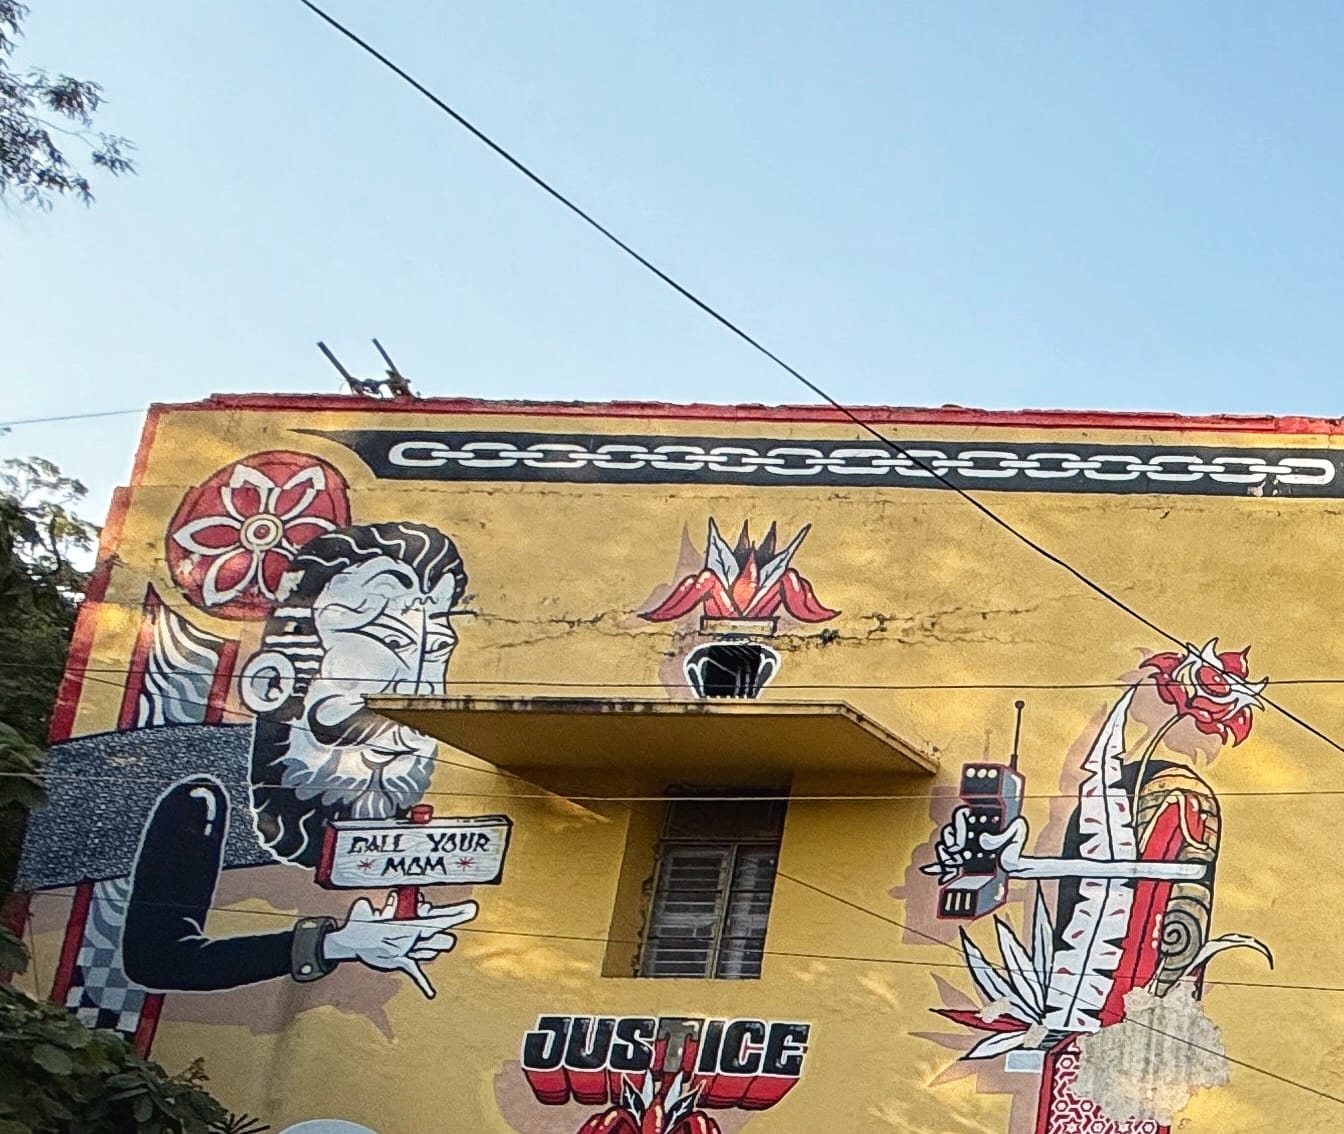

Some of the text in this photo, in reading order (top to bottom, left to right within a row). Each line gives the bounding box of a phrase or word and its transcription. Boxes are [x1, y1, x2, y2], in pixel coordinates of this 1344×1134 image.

[348, 832, 490, 854] CALL YOUR
[381, 856, 448, 877] MOM
[521, 1014, 812, 1088] JUSTICE
